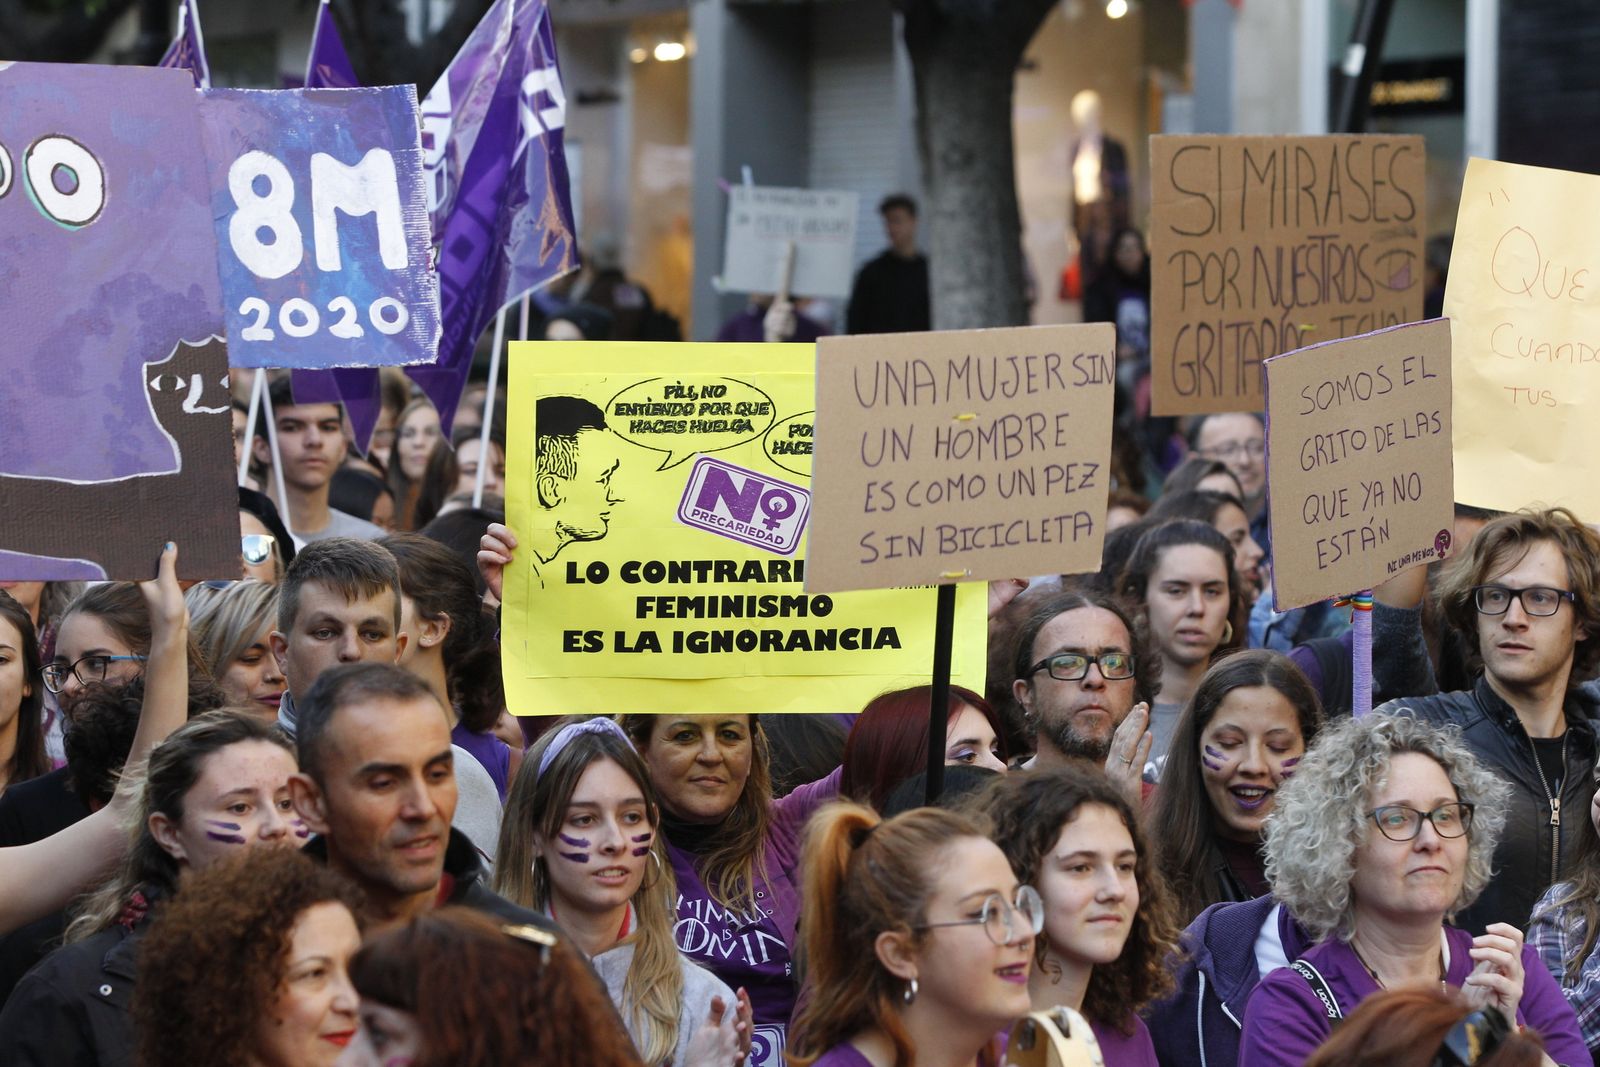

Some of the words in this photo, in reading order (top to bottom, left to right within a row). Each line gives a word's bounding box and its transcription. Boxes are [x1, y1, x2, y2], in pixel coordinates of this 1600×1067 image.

[1170, 143, 1222, 237] SI
[1240, 140, 1416, 232] MIRASES
[228, 148, 409, 279] 8M
[1167, 247, 1242, 312] POR
[1251, 234, 1375, 310] NUESTROS
[239, 296, 410, 341] 2020
[700, 384, 727, 399] NO
[853, 358, 937, 409] UNA
[945, 353, 1066, 403] MUJER
[1072, 350, 1116, 387] SIN
[1300, 365, 1393, 415] SOMOS
[1402, 355, 1437, 386] EL
[1503, 386, 1558, 408] TUS
[629, 419, 688, 434] HACEIS
[689, 418, 755, 434] HUELGA
[699, 402, 733, 416] POR
[734, 401, 771, 417] QUE
[788, 424, 814, 438] PO
[772, 441, 814, 455] HACE
[861, 423, 914, 468] UN
[935, 412, 1070, 461] HOMBRE
[1300, 429, 1367, 472] GRITO
[1374, 422, 1396, 453] DE
[1403, 410, 1442, 440] LAS
[864, 480, 896, 513] ES
[906, 473, 986, 508] COMO
[998, 466, 1036, 499] UN
[1043, 463, 1100, 496] PEZ
[1302, 488, 1349, 525] QUE
[1360, 481, 1384, 511] YA
[1392, 472, 1422, 504] NO
[691, 508, 785, 545] PRECARIEDAD
[860, 526, 925, 564] SIN
[936, 510, 1094, 556] BICICLETA
[1316, 516, 1391, 570] ESTÁN
[566, 561, 610, 585] LO
[619, 559, 804, 585] CONTRARI
[1387, 560, 1397, 574] NI
[1399, 554, 1411, 569] UNA
[635, 593, 834, 619] FEMINISMO
[562, 630, 605, 653] ES
[613, 630, 663, 653] LA
[672, 626, 902, 654] IGNORANCIA
